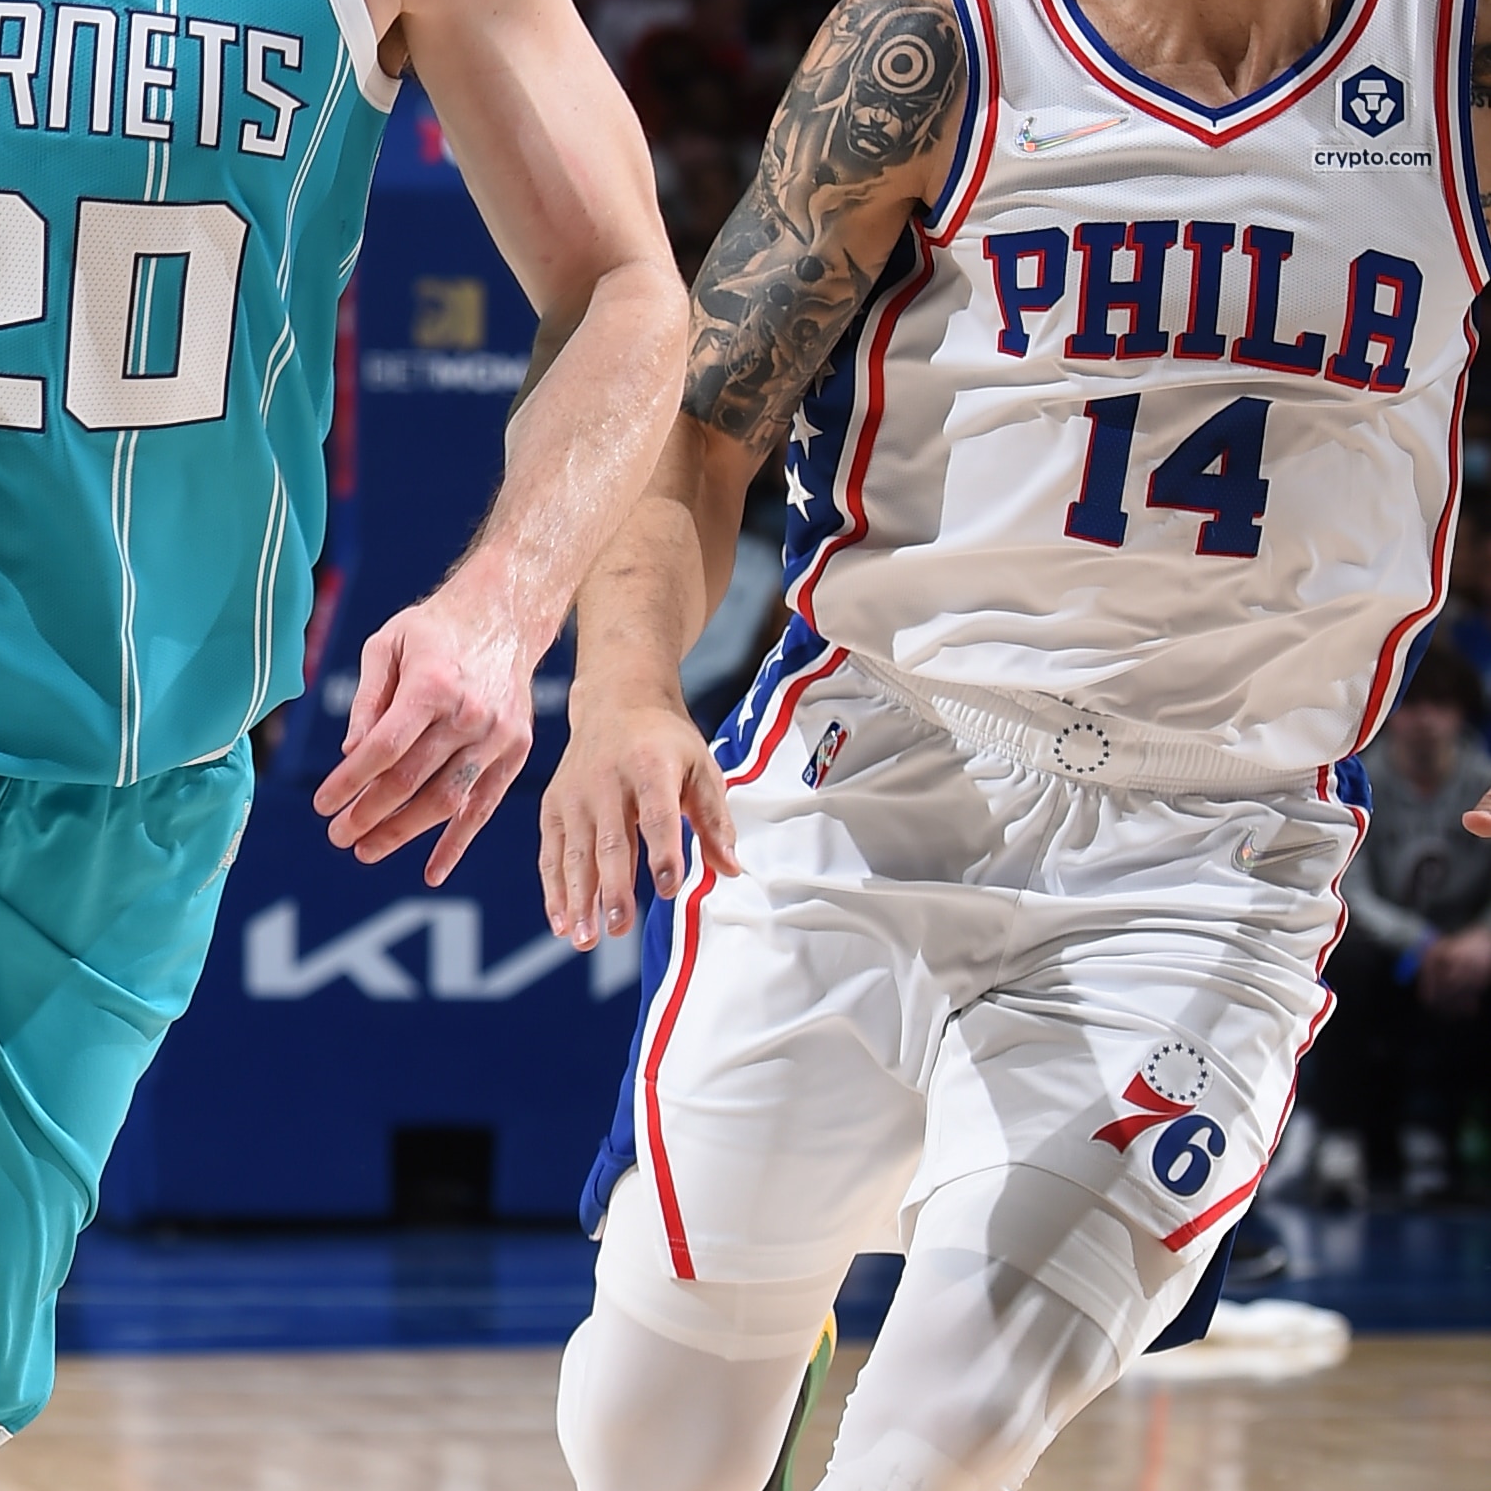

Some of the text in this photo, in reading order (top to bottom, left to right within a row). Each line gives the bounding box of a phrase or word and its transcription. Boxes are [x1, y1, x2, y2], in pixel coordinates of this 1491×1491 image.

[1314, 148, 1432, 169] crypto.com
[982, 219, 1424, 394] PHILA
[1063, 391, 1274, 559] 14
